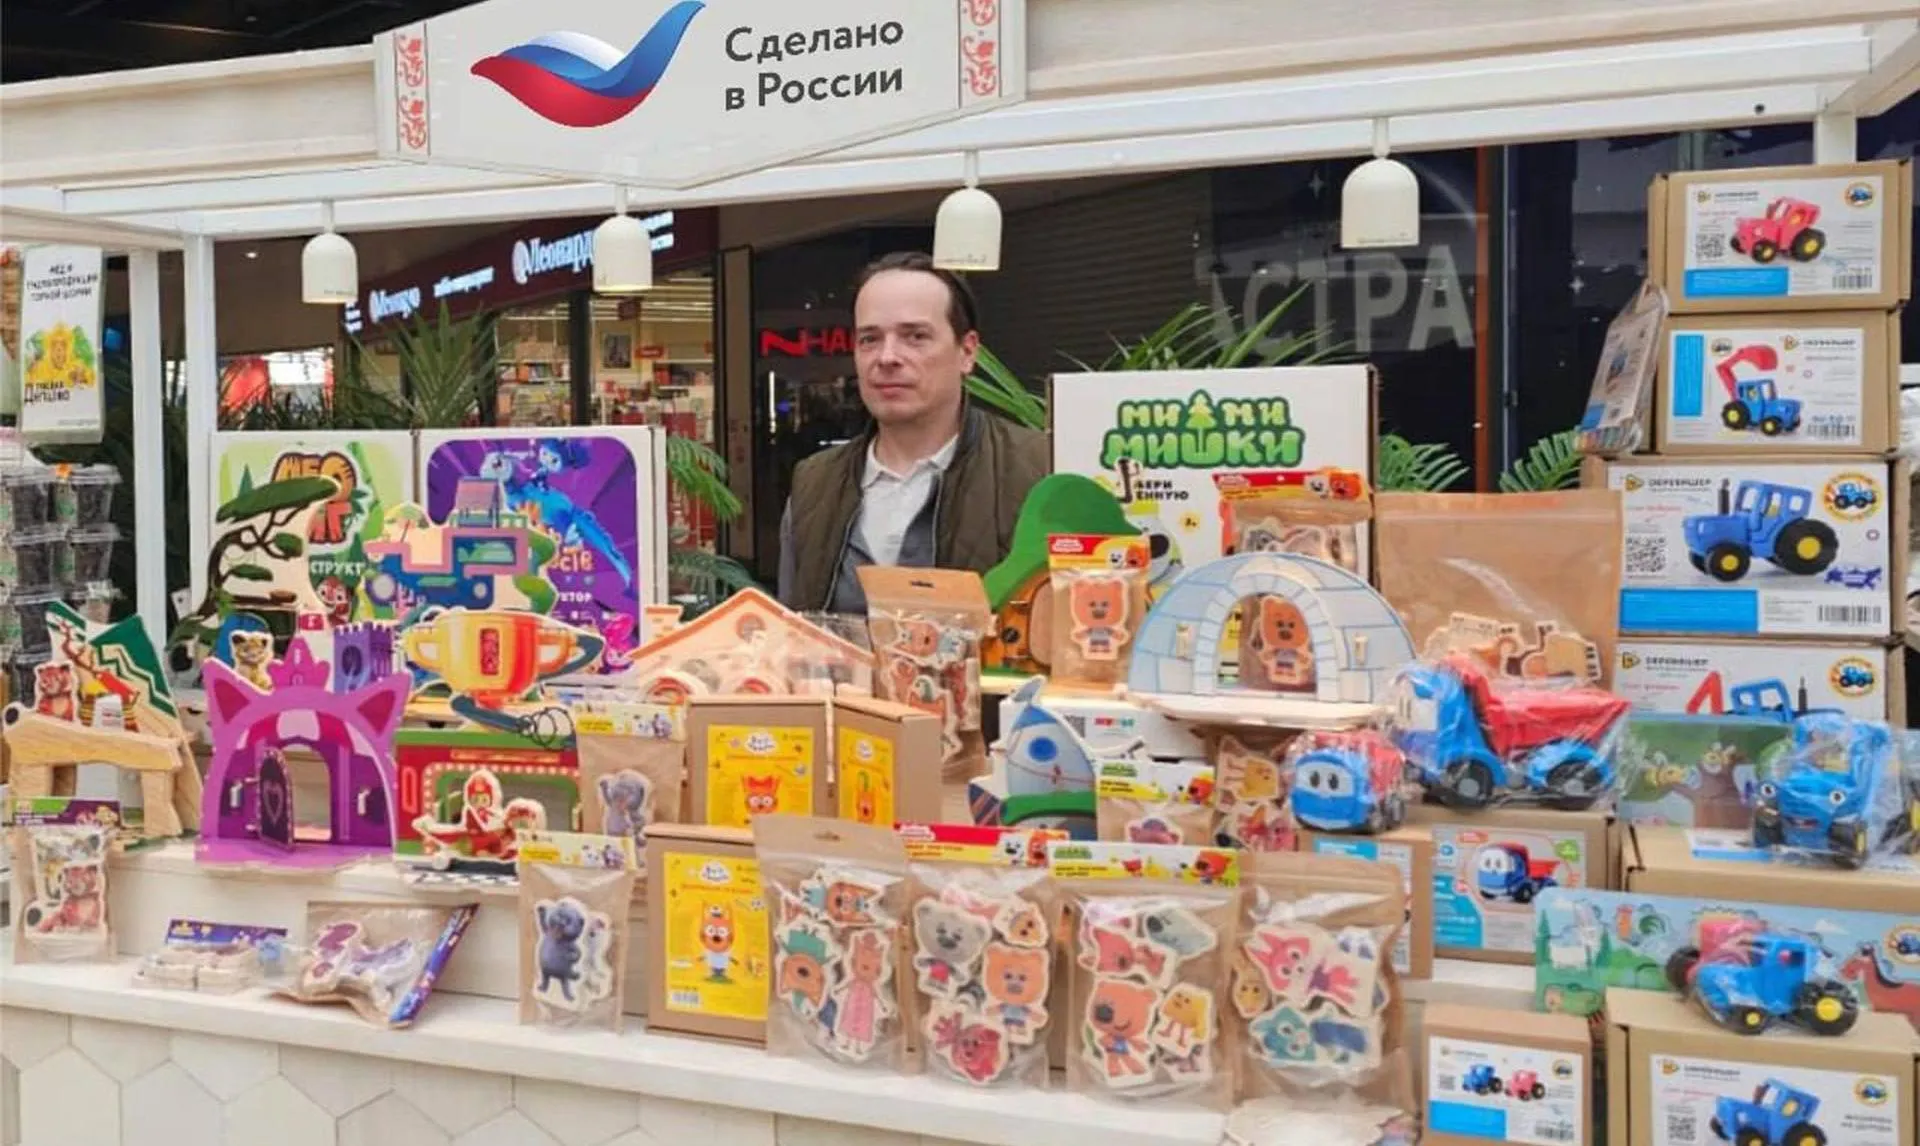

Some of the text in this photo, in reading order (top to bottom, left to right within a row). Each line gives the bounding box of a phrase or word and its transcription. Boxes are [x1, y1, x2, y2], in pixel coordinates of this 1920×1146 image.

[725, 21, 904, 64] Сделано
[725, 68, 903, 110] в России
